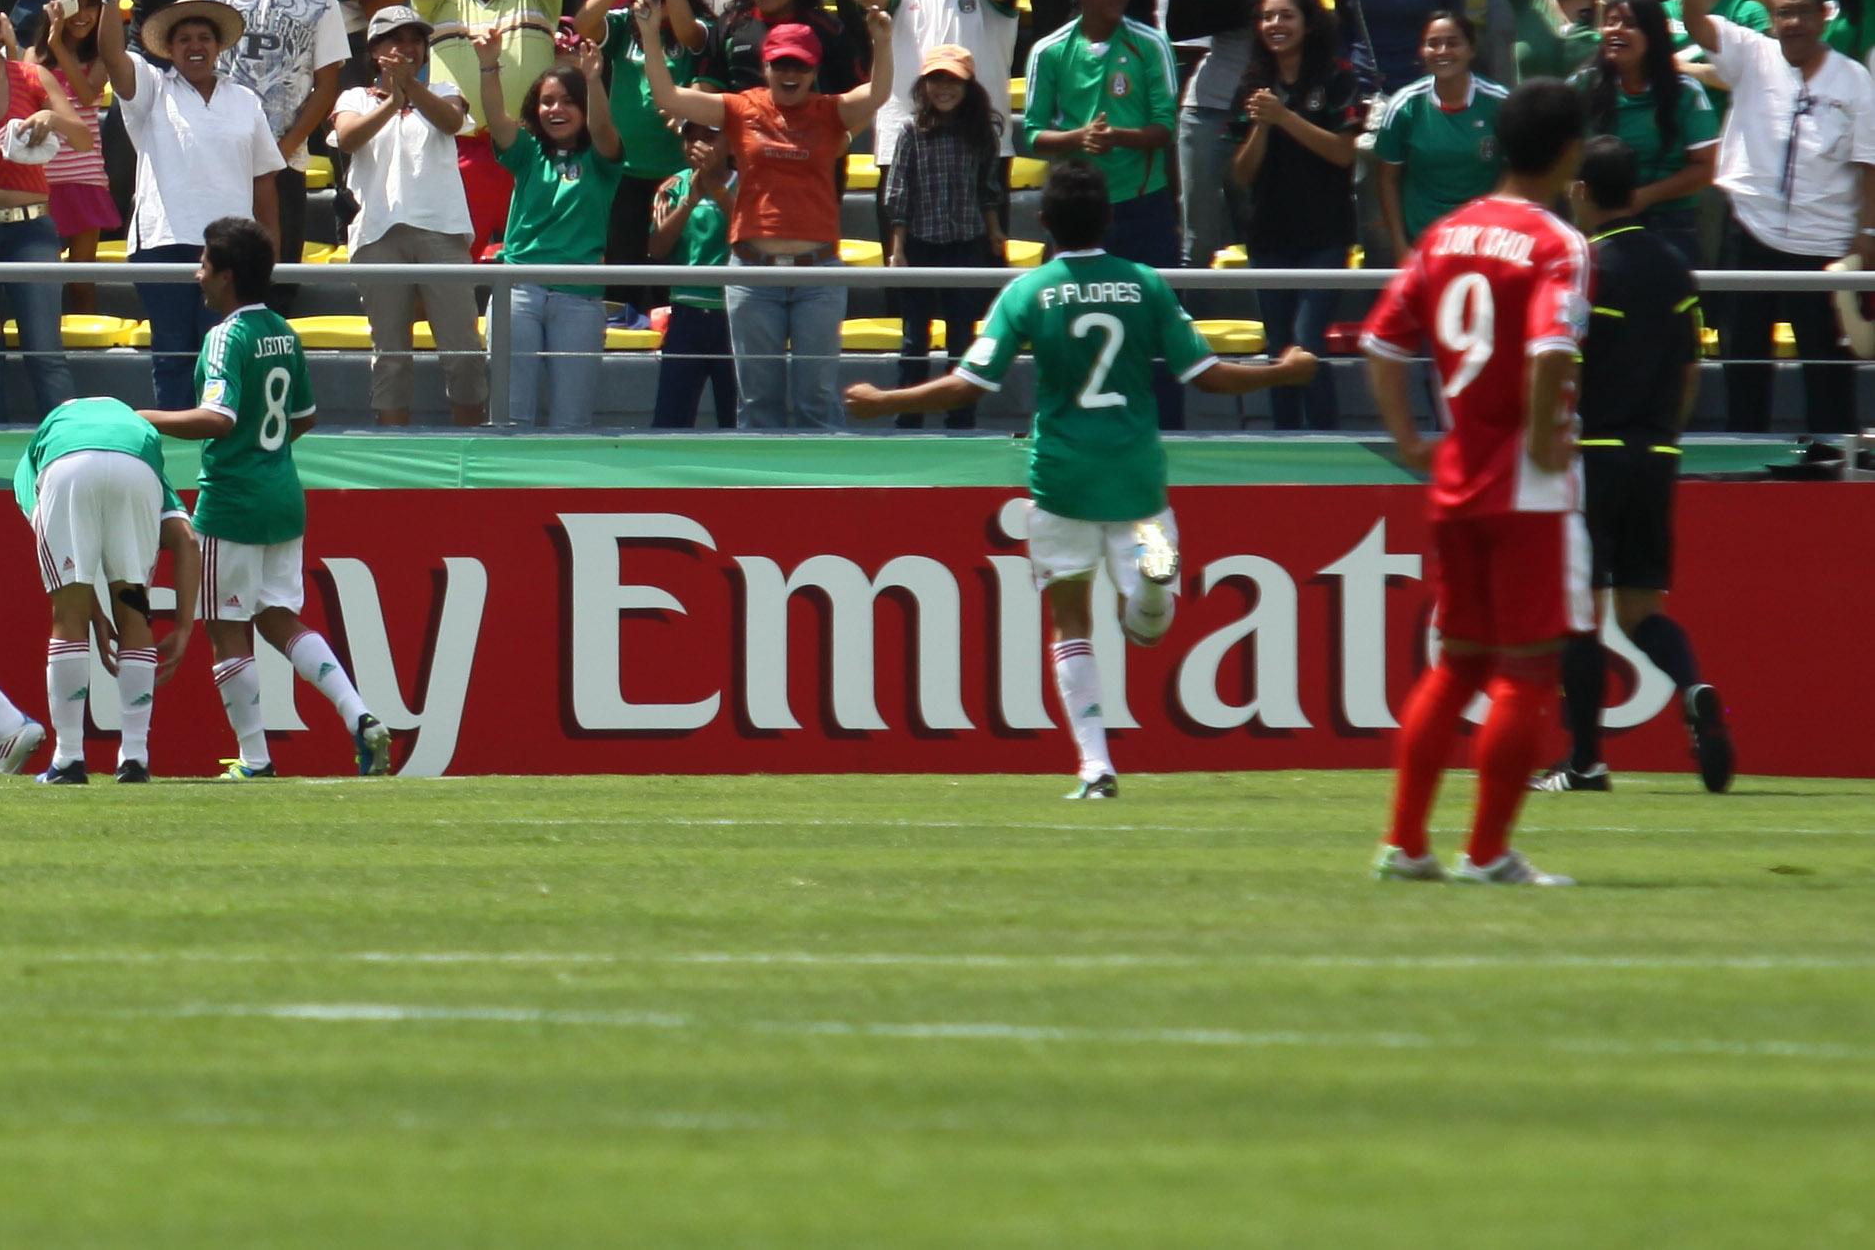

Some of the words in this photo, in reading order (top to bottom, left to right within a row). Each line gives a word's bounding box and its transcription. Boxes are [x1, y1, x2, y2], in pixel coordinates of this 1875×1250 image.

[1072, 312, 1128, 409] 2
[1437, 273, 1496, 398] 9
[259, 366, 292, 452] 8
